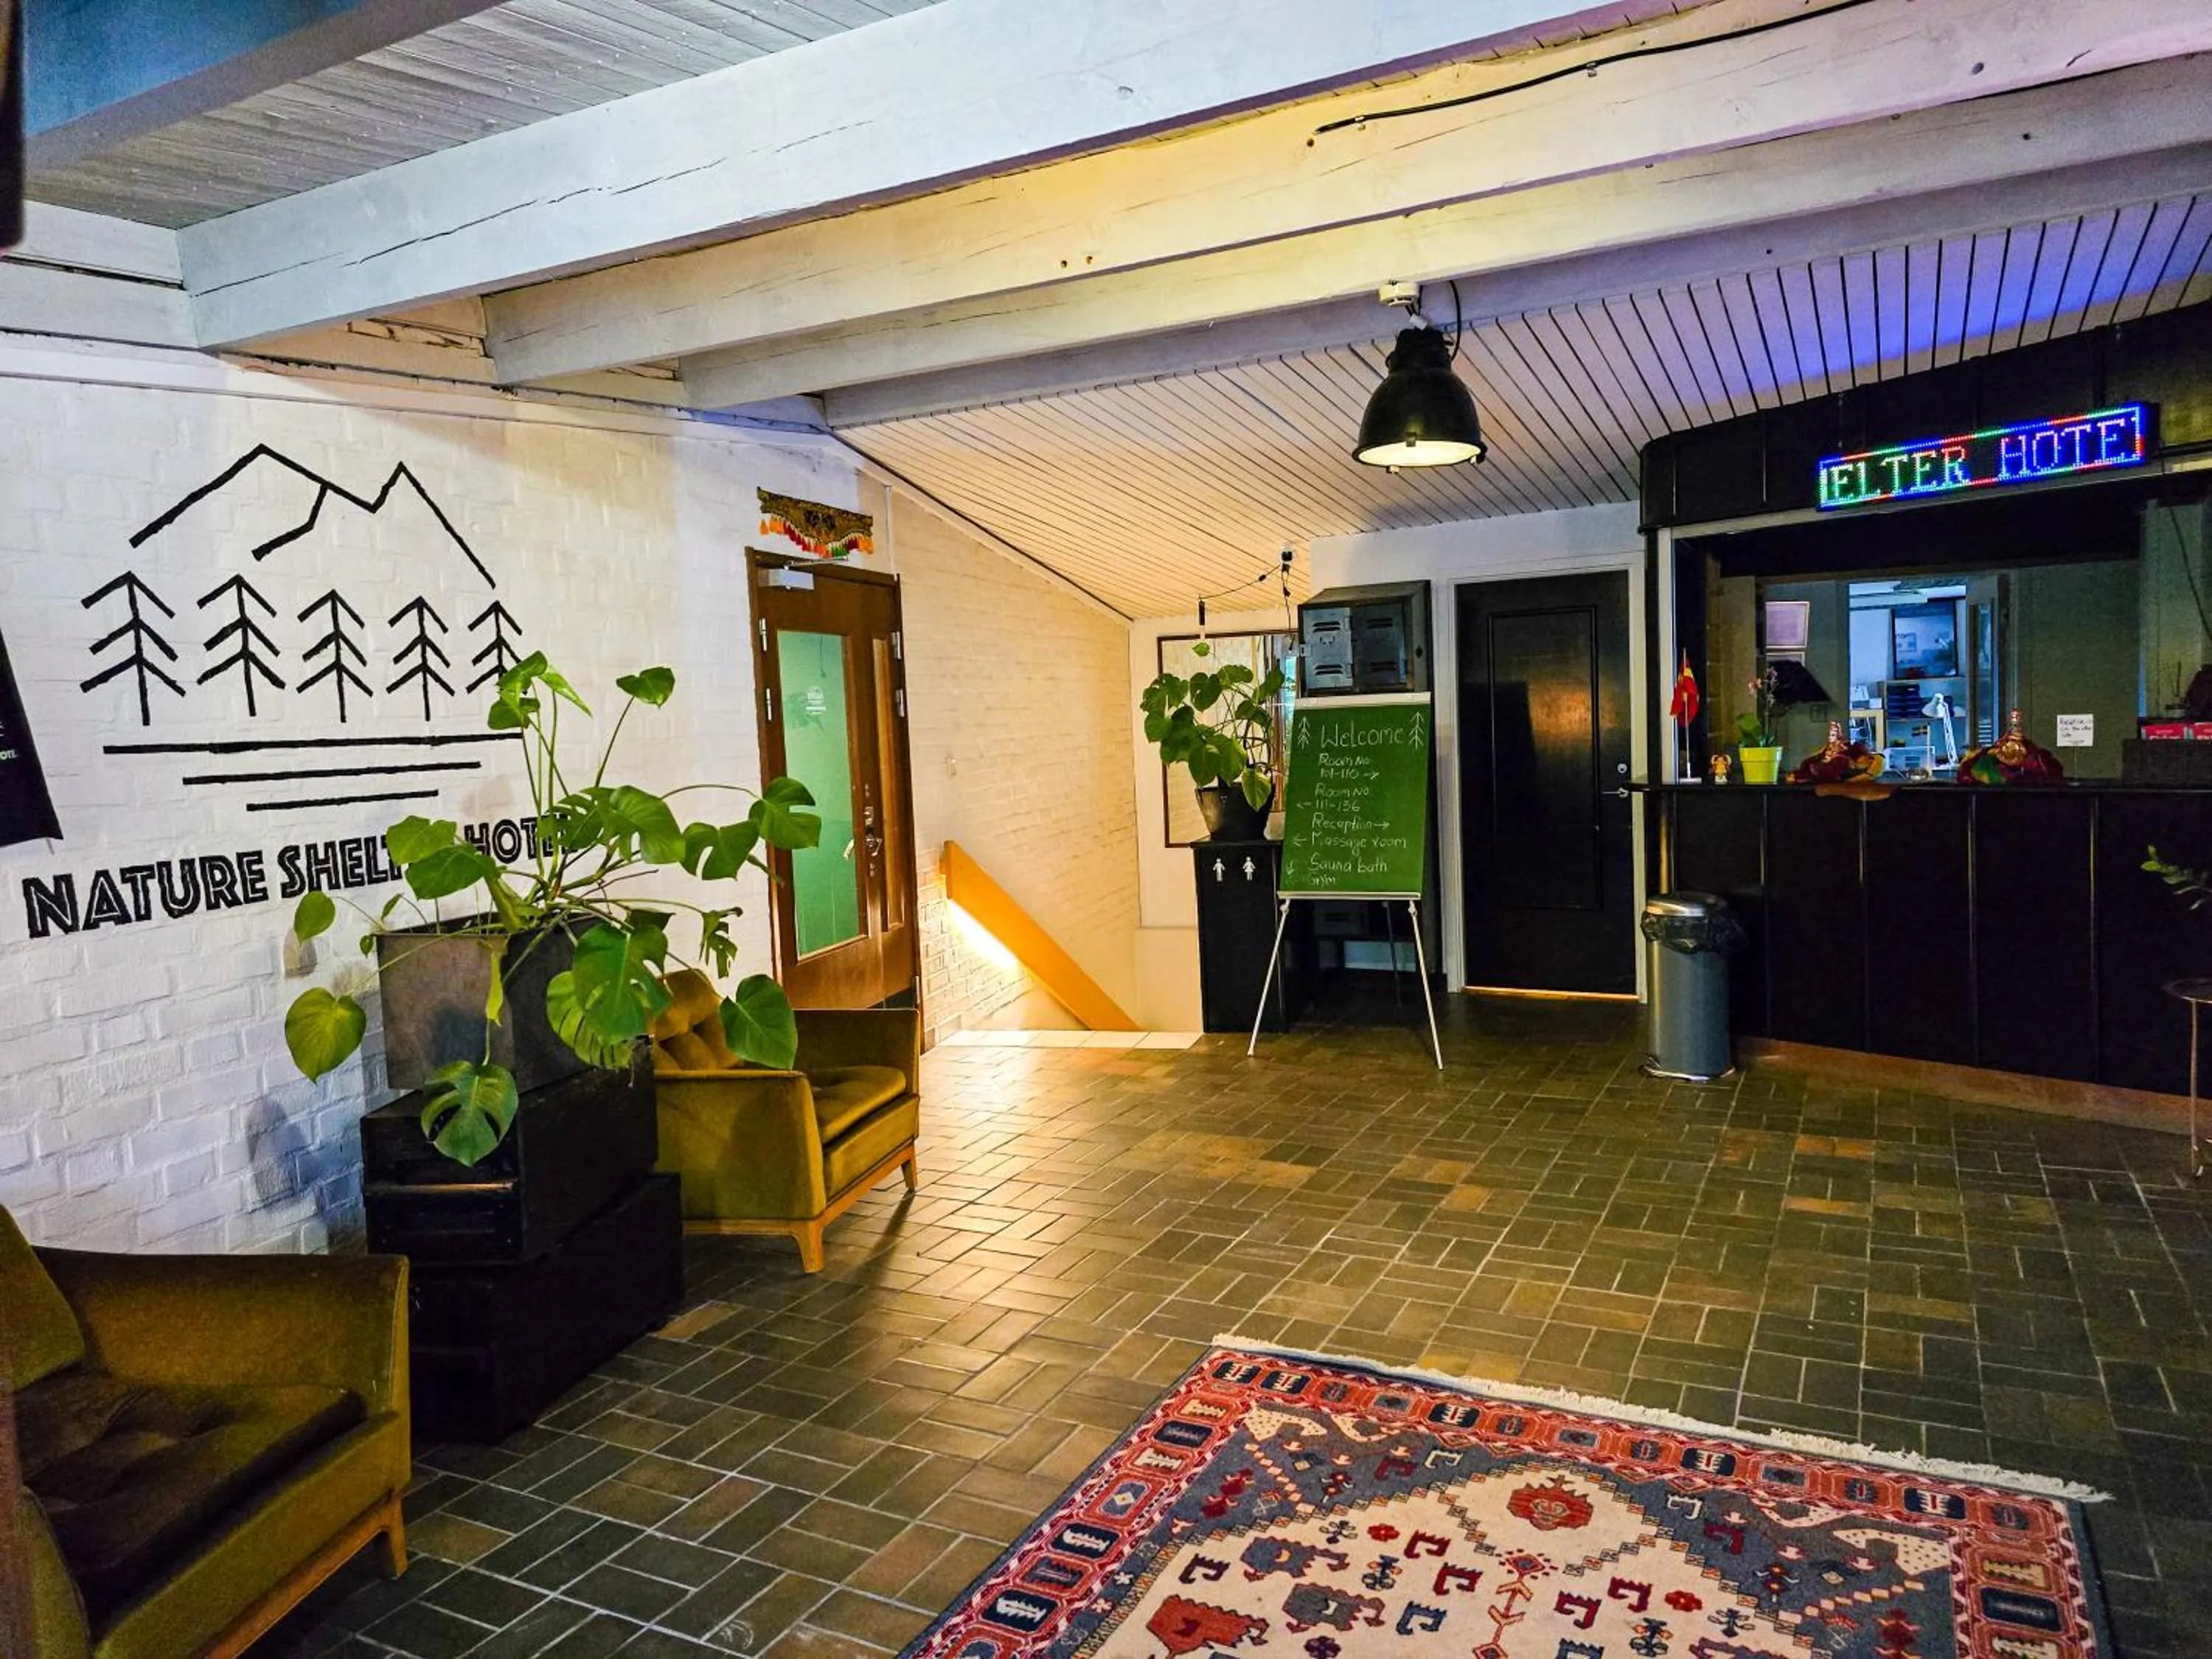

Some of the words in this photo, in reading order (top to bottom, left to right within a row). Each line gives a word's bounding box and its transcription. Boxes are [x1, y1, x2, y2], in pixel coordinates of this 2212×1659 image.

[1820, 445, 1969, 506] ELTER
[1998, 417, 2137, 479] HOTE
[1320, 719, 1404, 748] Welcome
[1318, 753, 1353, 767] Room
[1315, 782, 1350, 797] Room
[1315, 799, 1360, 812] 111-136
[1312, 831, 1366, 857] Massage
[1372, 836, 1407, 849] room
[1310, 852, 1352, 872] Sauna
[1357, 855, 1388, 873] bath
[21, 849, 269, 939] NATURE
[277, 833, 454, 899] SHEL
[464, 813, 578, 864] HOT
